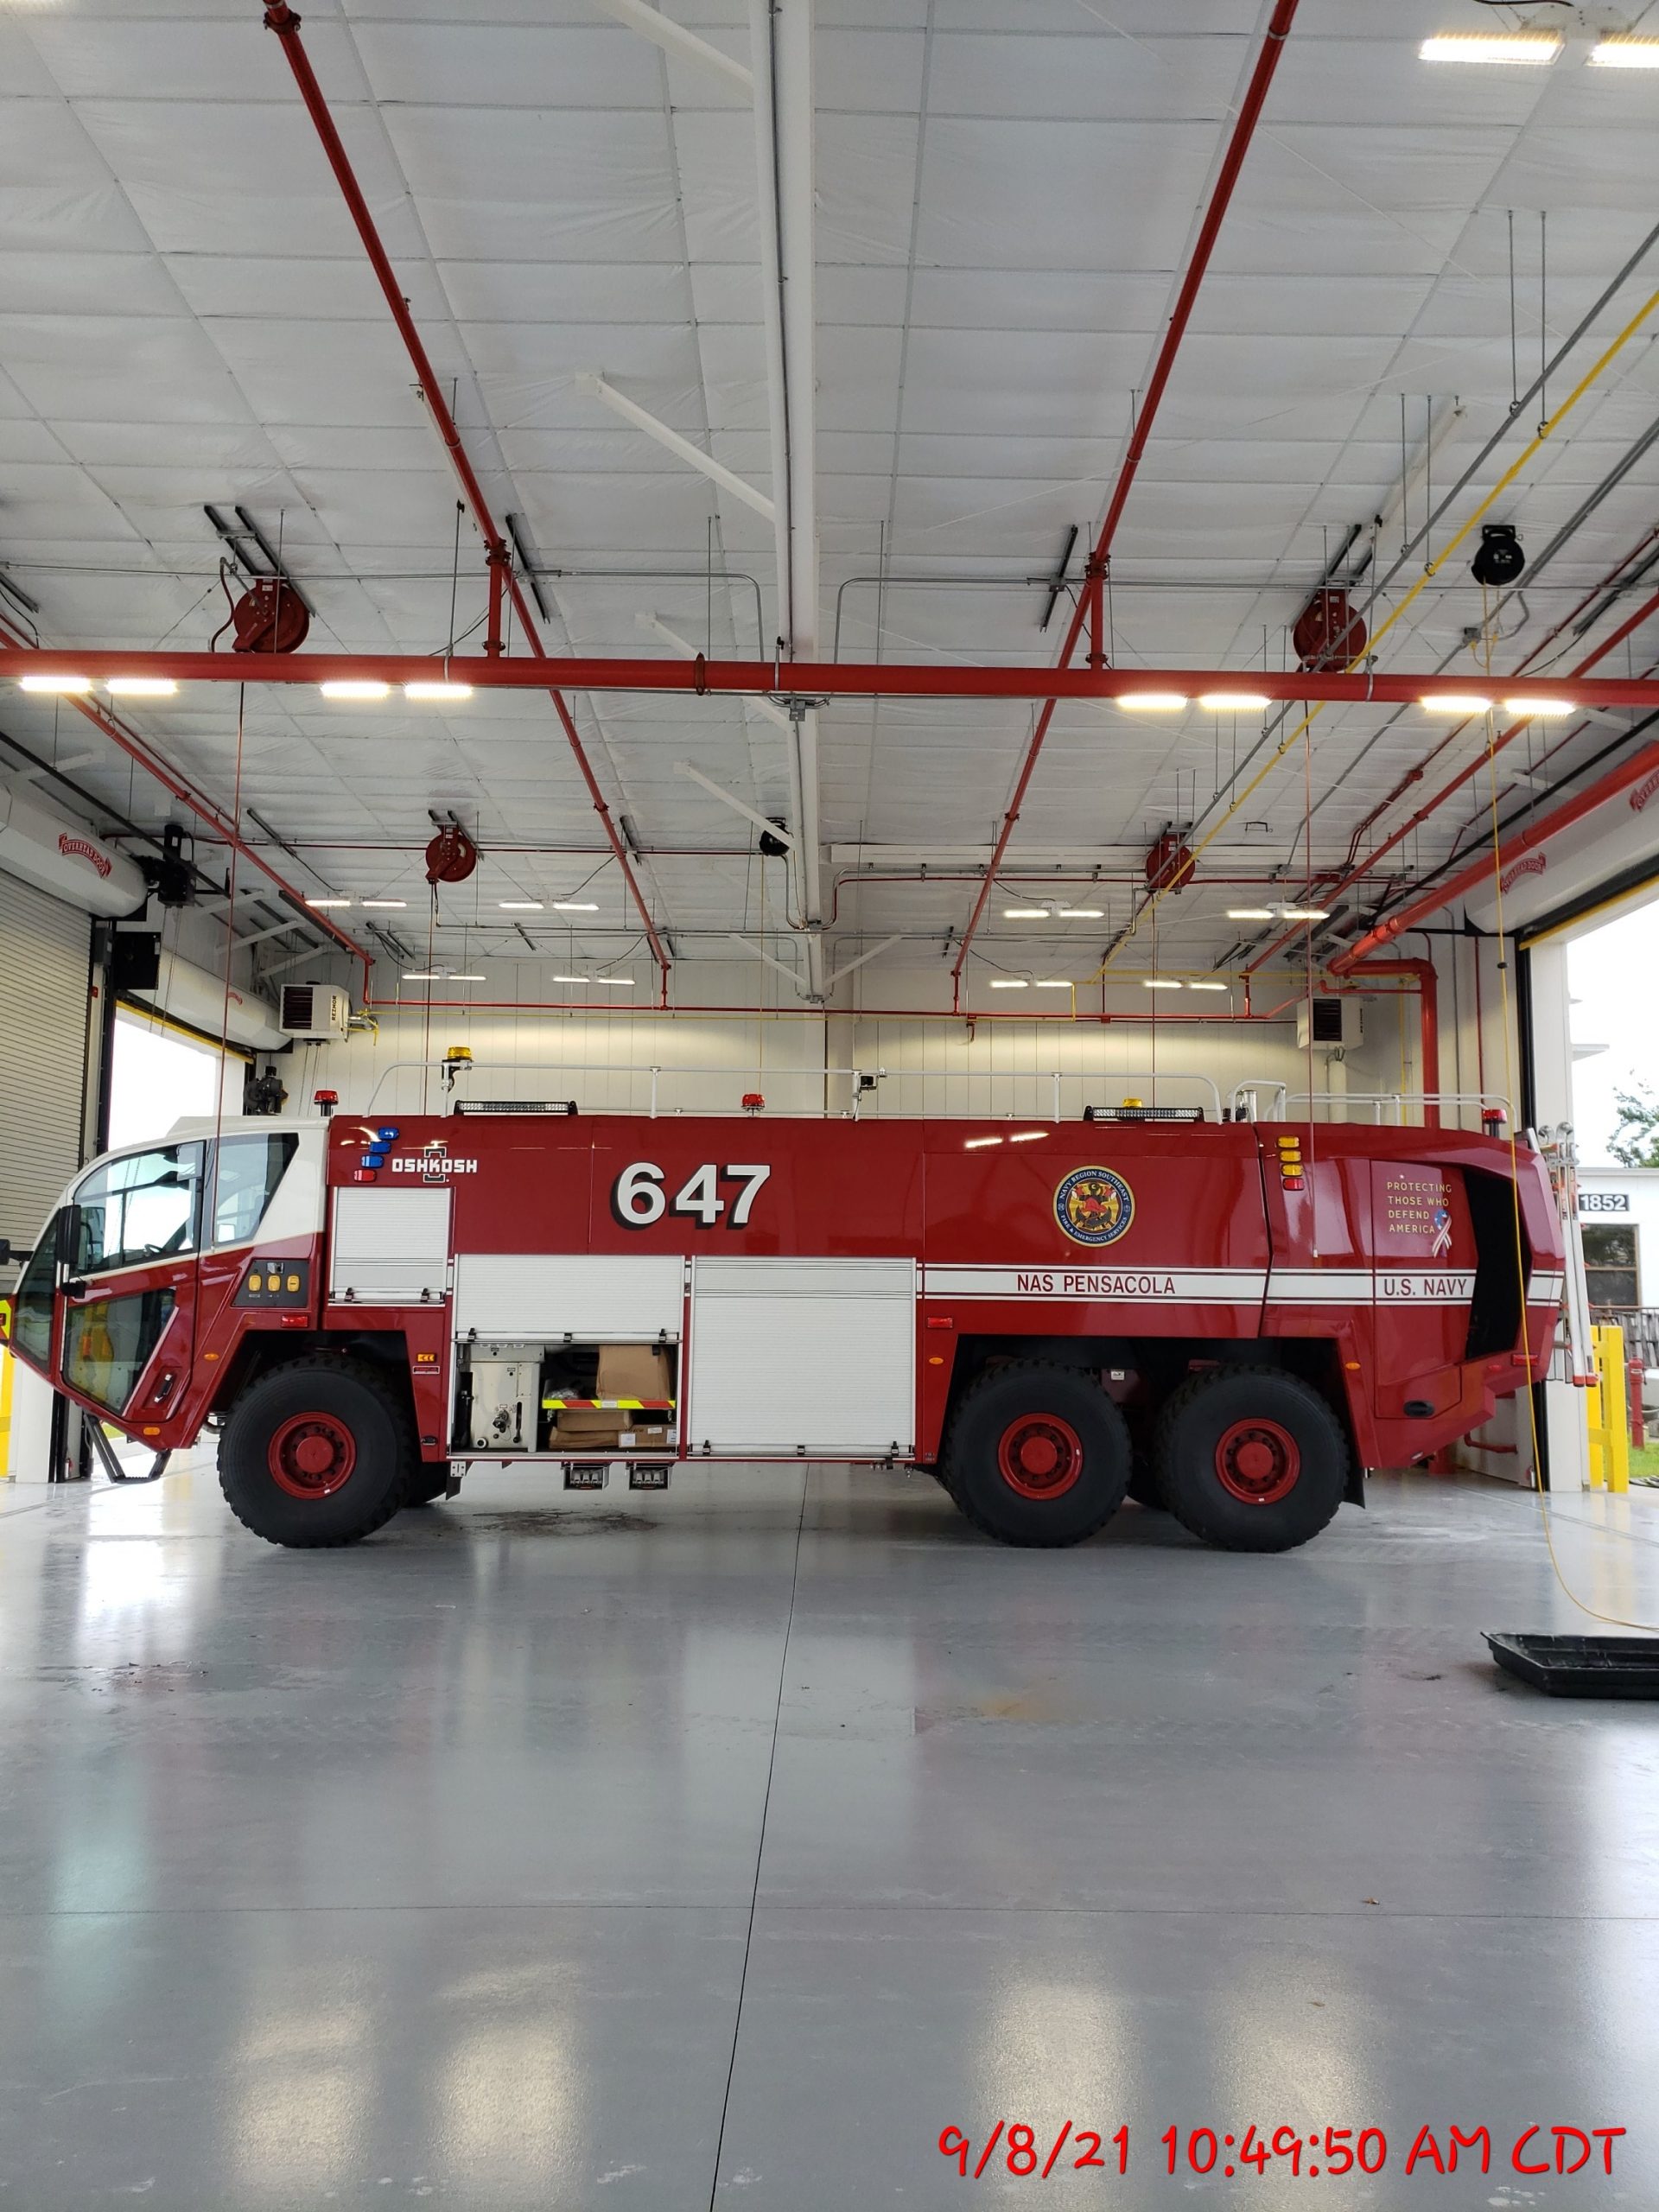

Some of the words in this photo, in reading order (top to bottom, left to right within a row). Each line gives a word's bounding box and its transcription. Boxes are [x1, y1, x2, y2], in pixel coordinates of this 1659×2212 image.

[63, 842, 93, 856] OVERHEAD
[392, 1159, 478, 1173] OSHKOSH
[1059, 1181, 1072, 1199] NAVY
[1071, 1170, 1097, 1182] REGION
[1098, 1171, 1129, 1202] SOUTHEAST
[1387, 1181, 1452, 1193] PROTECTING
[613, 1162, 771, 1229] 647
[1388, 1195, 1422, 1205] THOSE
[1427, 1197, 1449, 1207] WHO
[1580, 1194, 1626, 1211] 1852
[1389, 1210, 1430, 1220] DEFEND
[1061, 1214, 1071, 1229] FIRE
[1073, 1230, 1107, 1242] EMERGENCY
[1108, 1217, 1128, 1238] SERVICES
[1389, 1224, 1435, 1234] AMERICA
[1017, 1274, 1054, 1292] NAS
[1064, 1274, 1176, 1294] PENSACOLA
[1384, 1278, 1416, 1296] U.S.
[1424, 1278, 1467, 1296] NAVY
